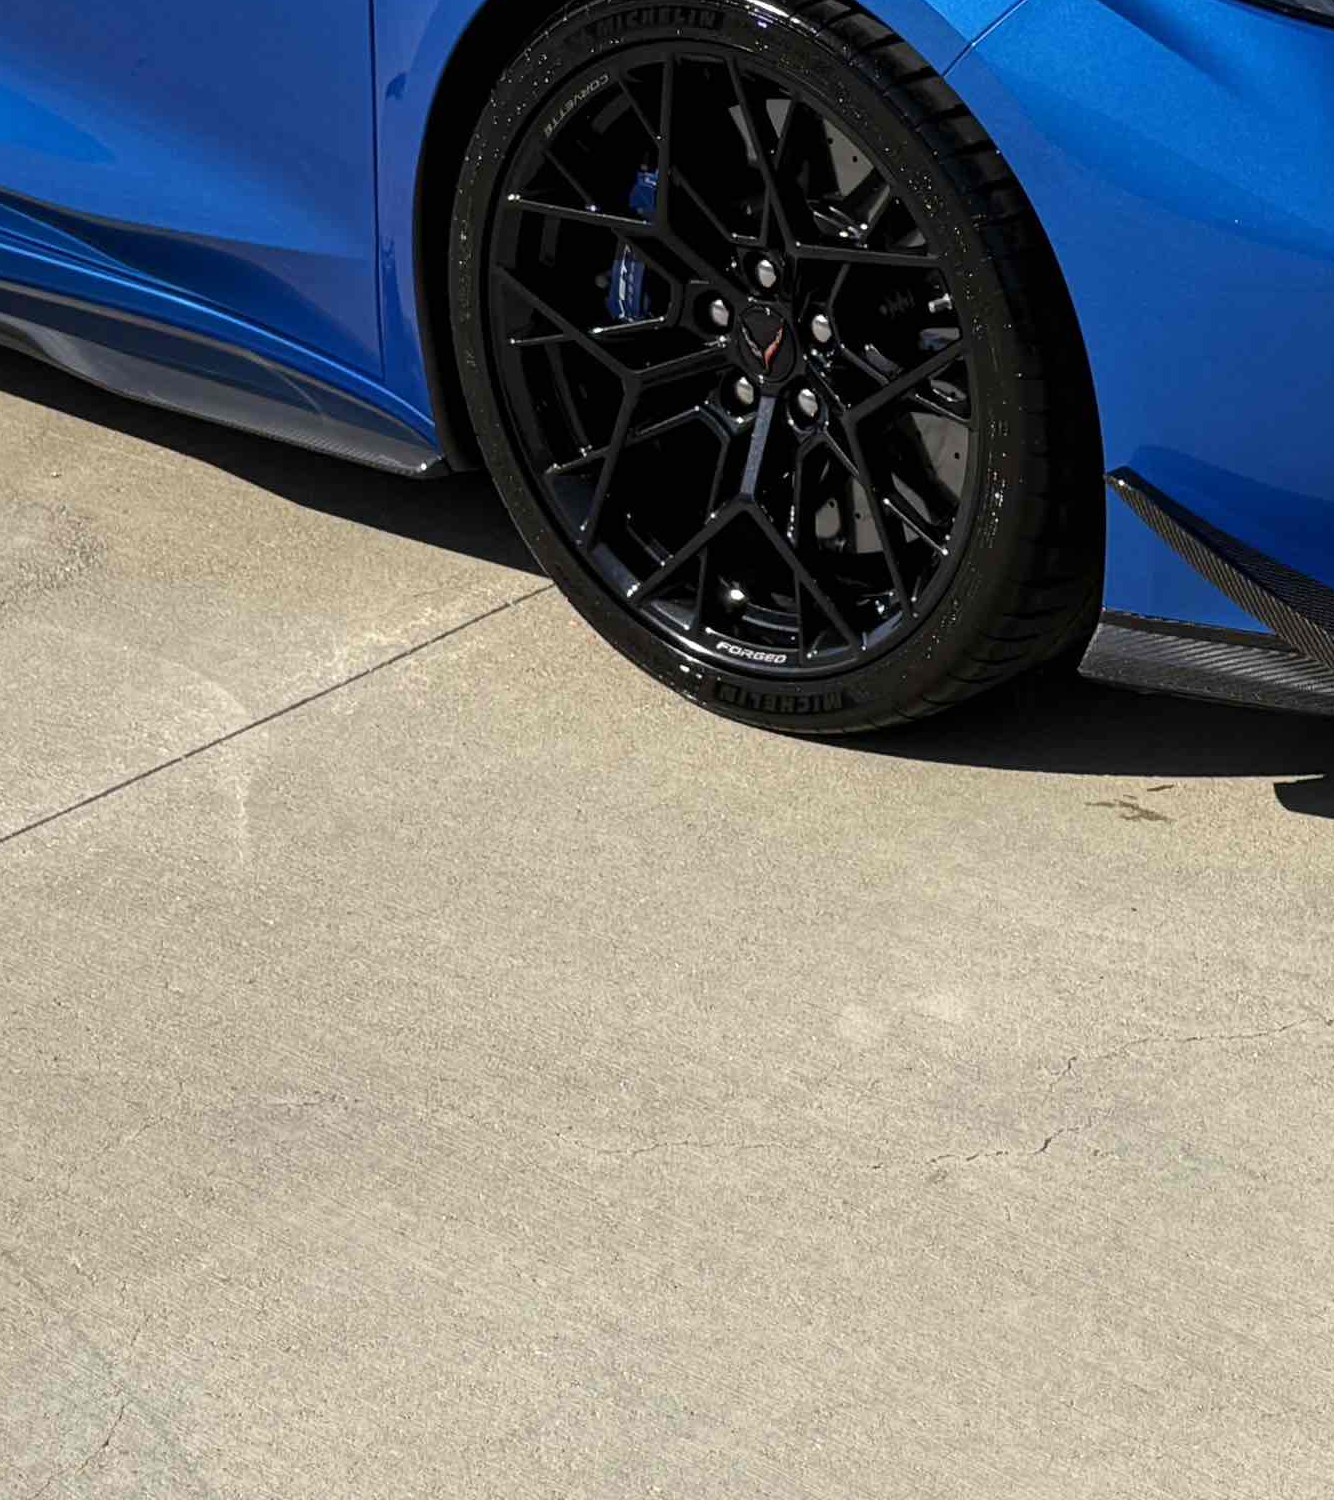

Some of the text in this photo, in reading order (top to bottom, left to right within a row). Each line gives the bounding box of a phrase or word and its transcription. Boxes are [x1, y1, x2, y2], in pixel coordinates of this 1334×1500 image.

[595, 5, 718, 38] MICHELIN
[539, 71, 611, 140] CORVETTE
[715, 641, 788, 665] FORGED
[717, 683, 844, 714] MICHELIN
